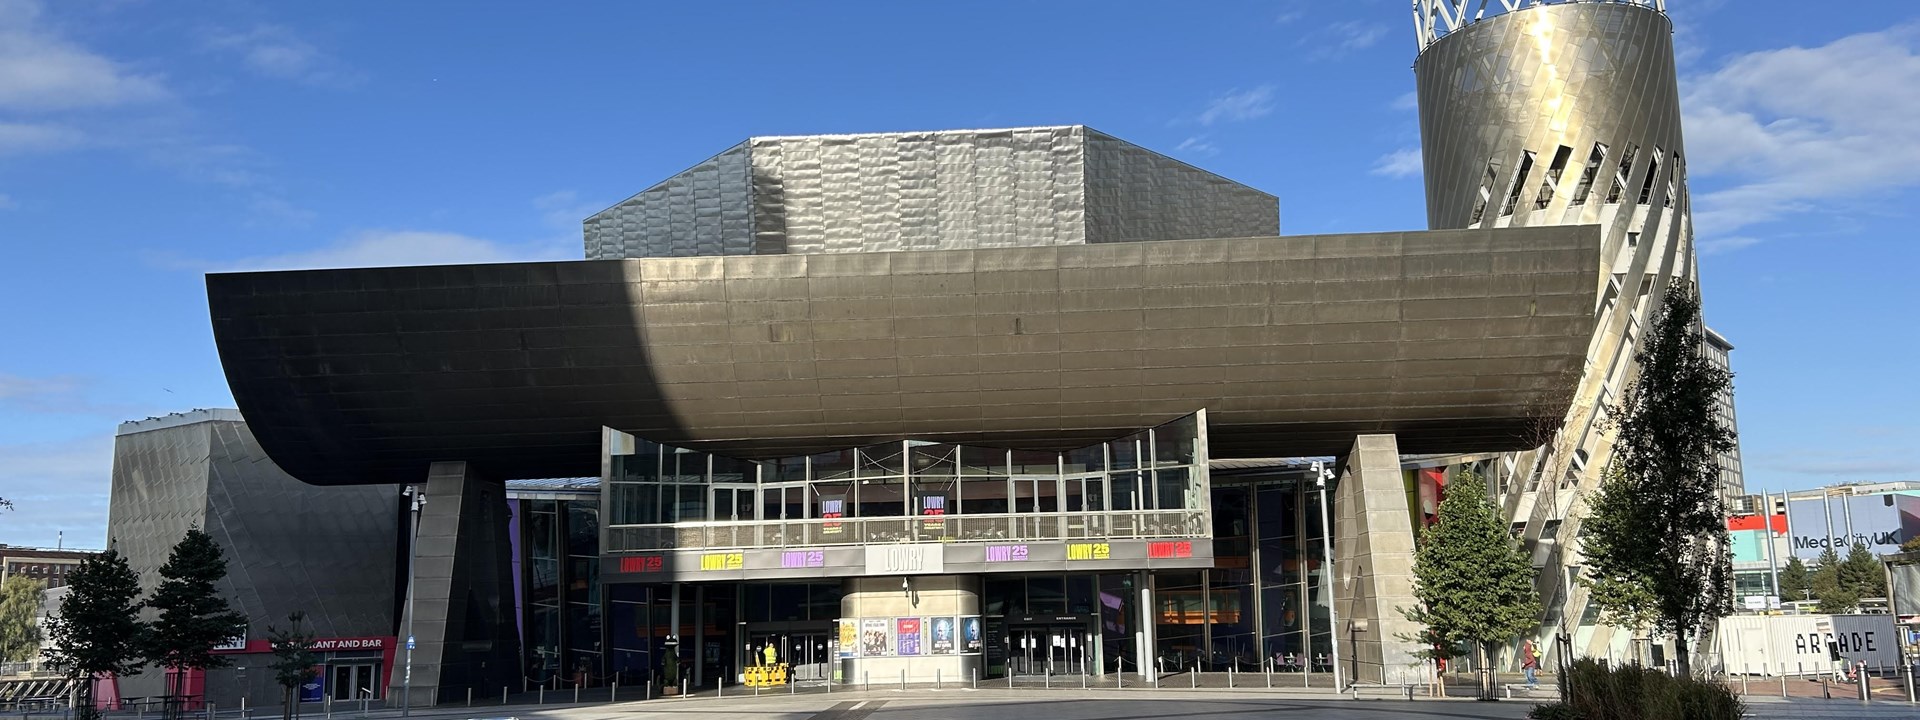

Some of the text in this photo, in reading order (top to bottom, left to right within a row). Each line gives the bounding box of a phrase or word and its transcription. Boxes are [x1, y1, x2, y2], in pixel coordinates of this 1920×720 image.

[822, 500, 842, 513] LOWRY
[923, 495, 945, 509] LOWRY
[1794, 531, 1899, 549] MedaCityUK
[986, 545, 1011, 562] LOWRY
[1012, 545, 1028, 555] 25
[1067, 543, 1093, 560] LOWRY
[1093, 543, 1109, 553] 25
[1148, 542, 1191, 558] LOWRY 25
[620, 557, 646, 573] LOWRY
[647, 556, 662, 567] 25
[701, 554, 726, 571] LOWRY
[727, 553, 743, 564] 25
[782, 551, 823, 568] LOWRY 25
[886, 547, 924, 571] LOWRY
[337, 640, 360, 648] AND
[362, 639, 382, 648] BAR
[1795, 631, 1877, 655] ARCADE
